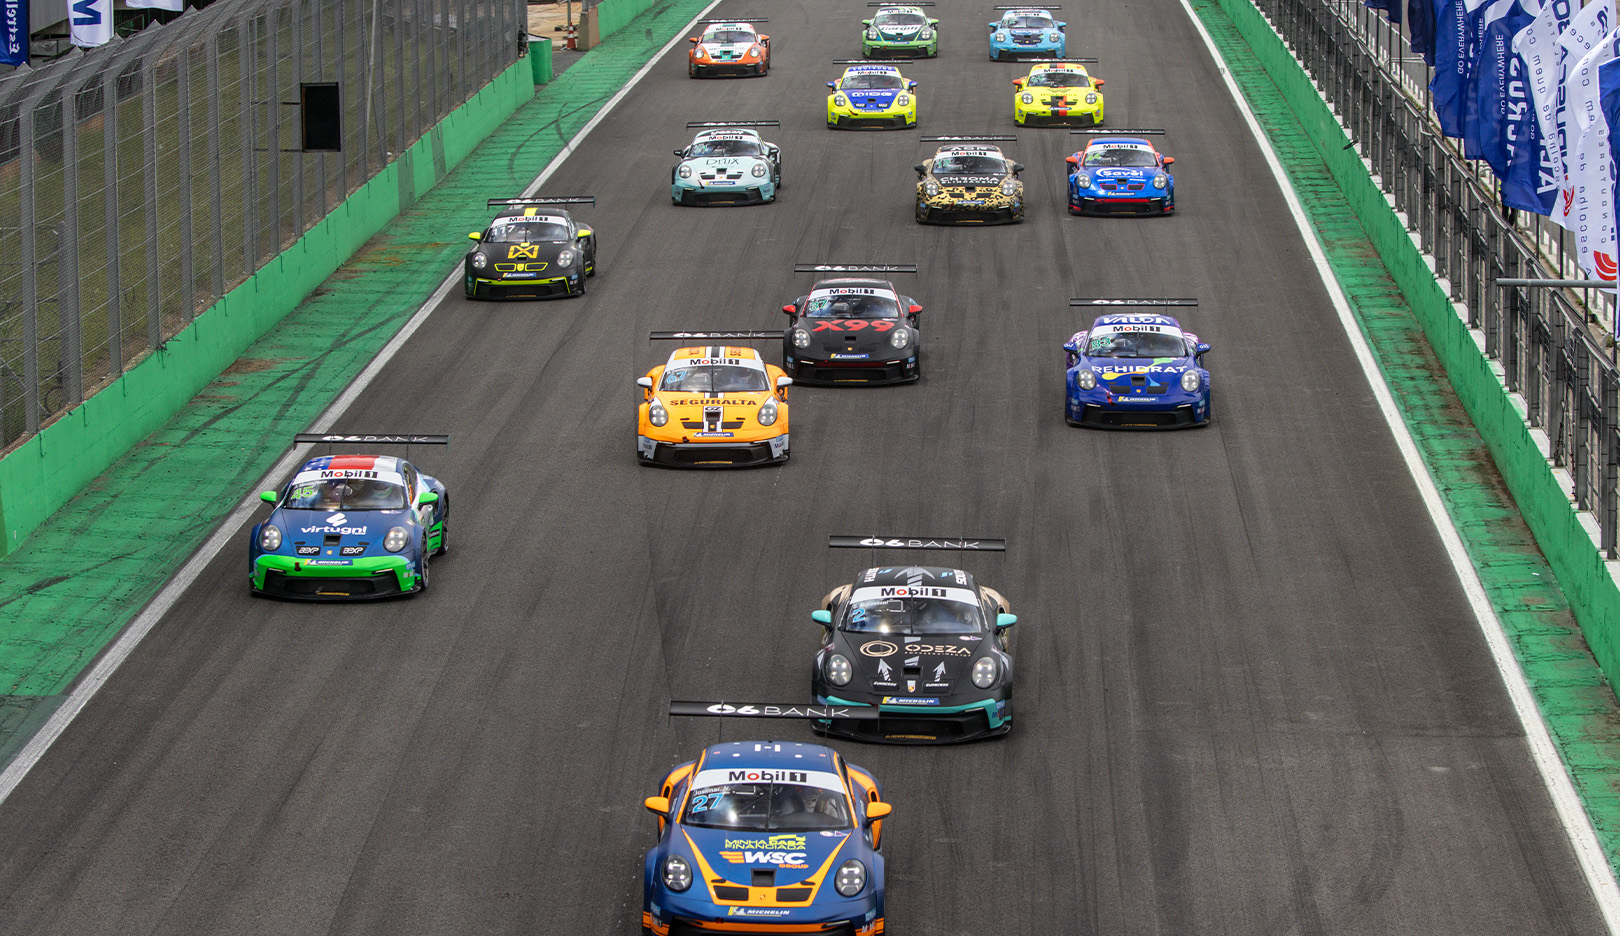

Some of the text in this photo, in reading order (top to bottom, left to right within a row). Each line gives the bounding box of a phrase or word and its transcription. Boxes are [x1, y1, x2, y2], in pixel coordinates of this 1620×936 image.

[811, 319, 896, 332] X99
[1102, 316, 1171, 325] VALDA
[689, 358, 726, 366] Mobil
[1091, 365, 1188, 374] REHIDRAT
[667, 371, 686, 384] 67
[320, 470, 362, 479] Mobil
[291, 486, 313, 500] 45
[908, 539, 980, 549] BANK
[880, 587, 929, 597] Mobil
[852, 608, 866, 623] 2
[905, 644, 971, 655] ODEZA
[764, 705, 850, 718] BANK
[728, 770, 785, 782] Mobil
[692, 792, 725, 814] 27
[724, 838, 767, 846] MINHA
[744, 851, 807, 865] WSC
